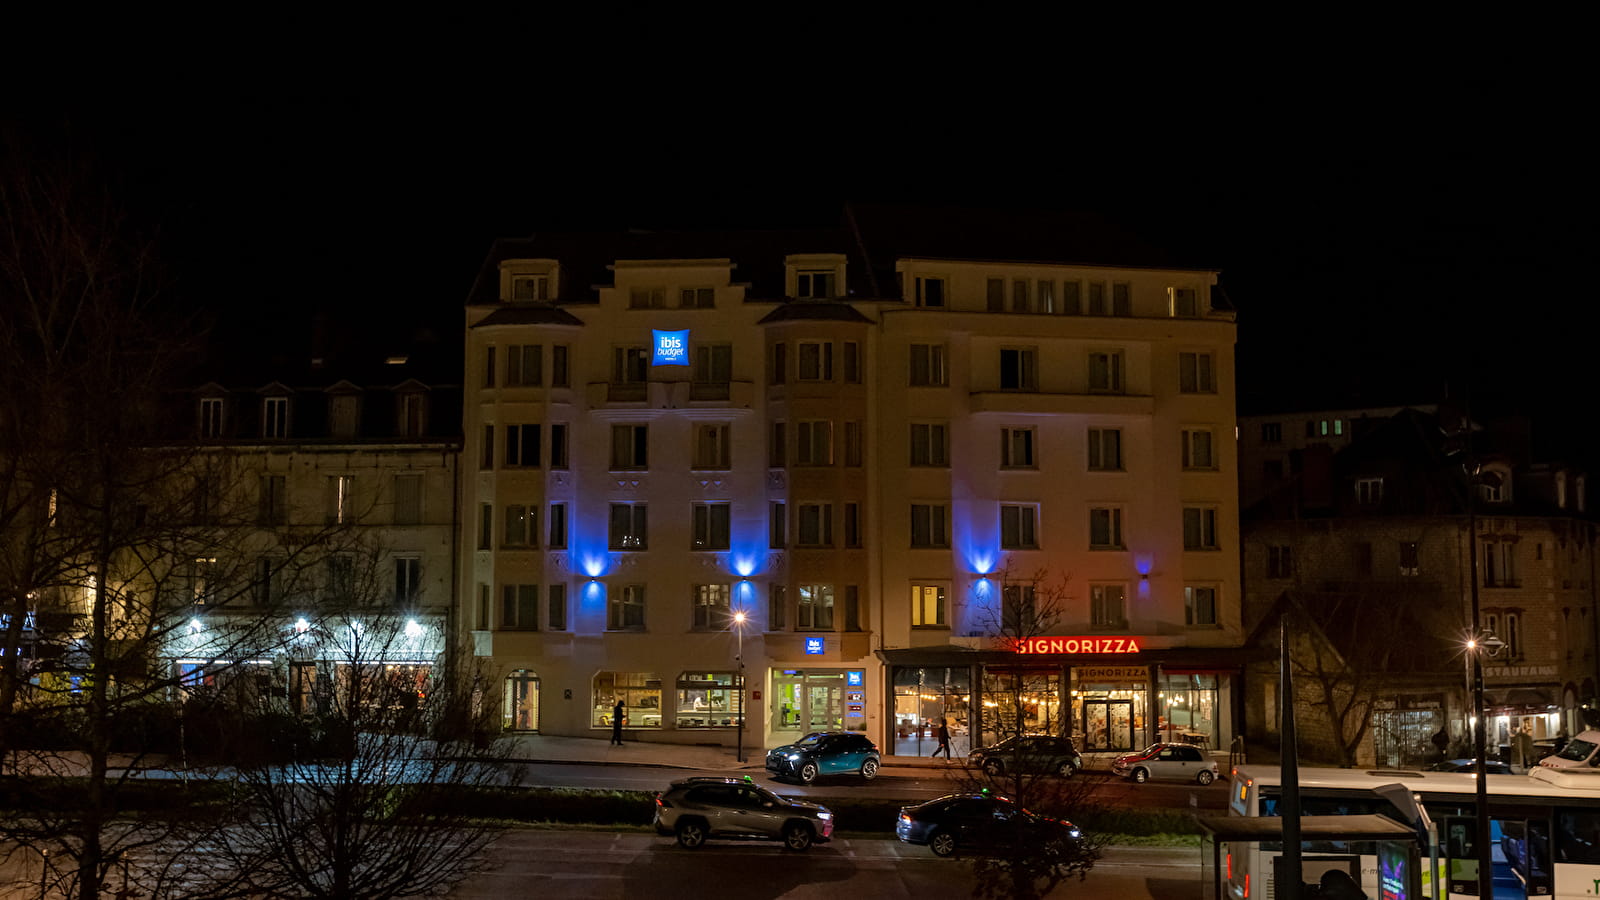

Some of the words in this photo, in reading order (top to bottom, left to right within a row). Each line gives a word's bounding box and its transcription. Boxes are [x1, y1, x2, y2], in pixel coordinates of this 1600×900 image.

[661, 337, 681, 348] ibis
[657, 348, 684, 357] budget
[1016, 639, 1139, 653] SIGNORIZZA
[1079, 668, 1146, 677] SIGNORIZZA
